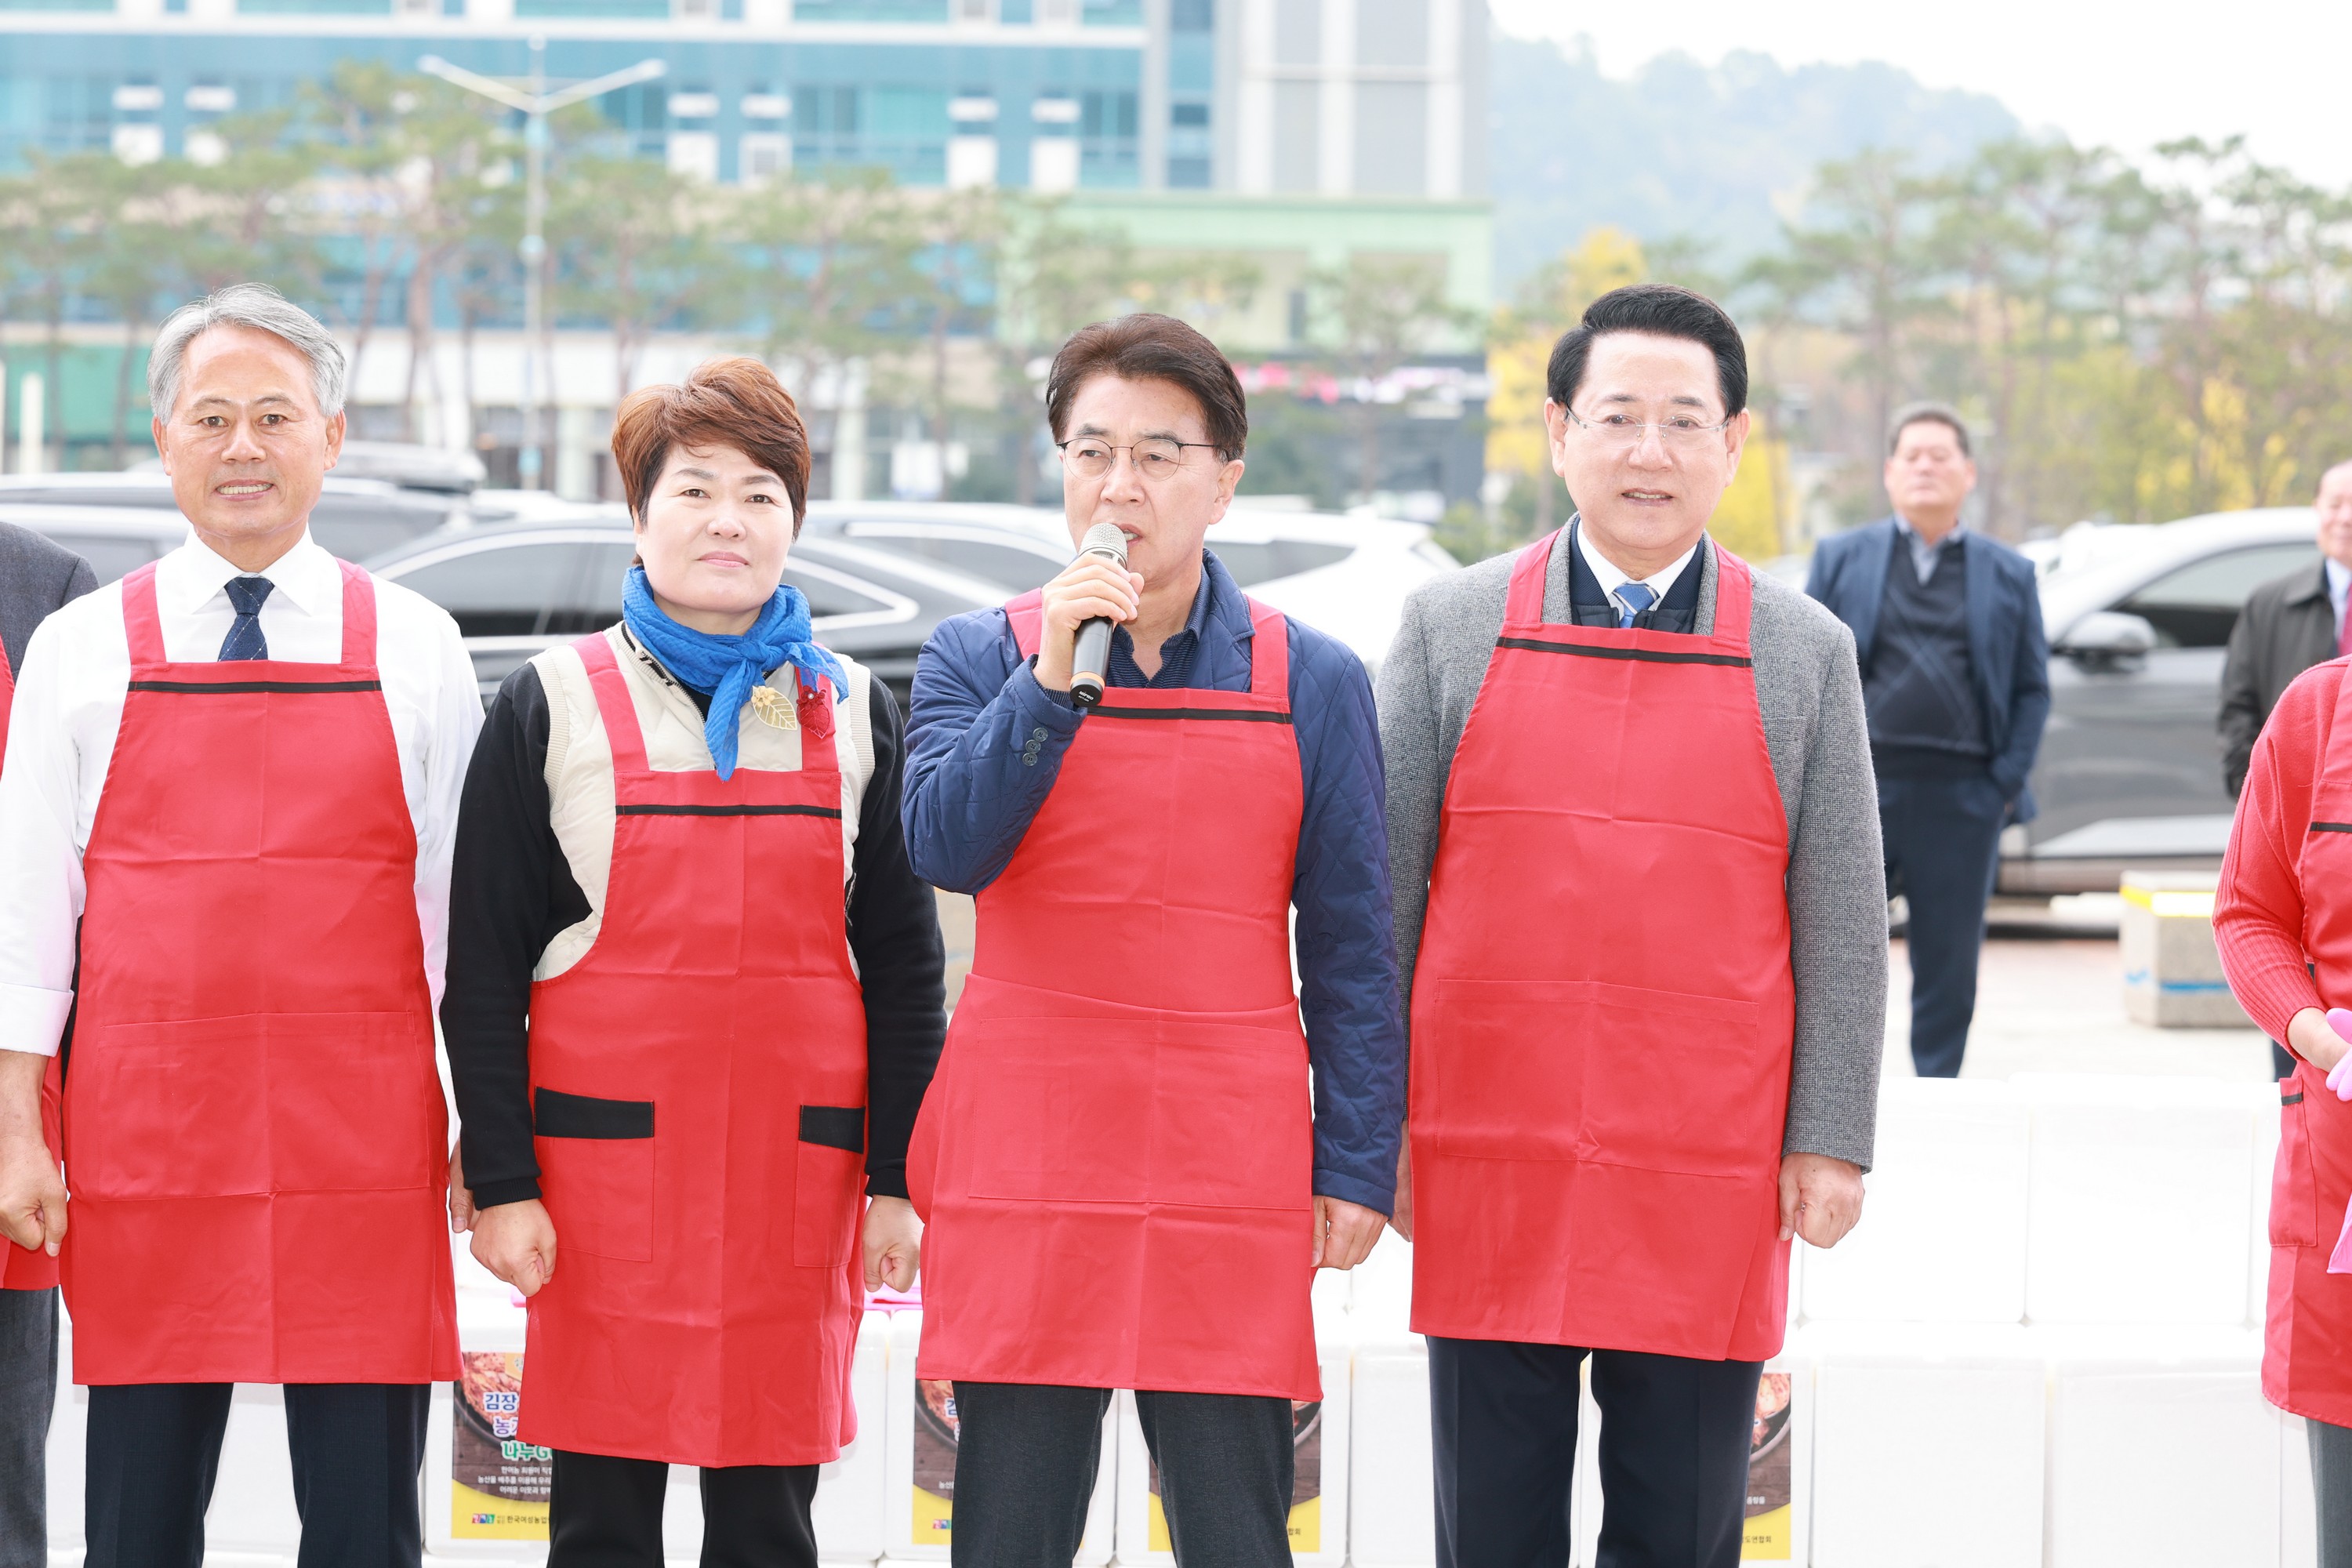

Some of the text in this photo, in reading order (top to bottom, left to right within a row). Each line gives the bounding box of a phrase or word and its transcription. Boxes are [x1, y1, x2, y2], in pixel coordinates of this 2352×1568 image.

[485, 1393, 518, 1411] 김장
[503, 1442, 552, 1460] 나누G
[1741, 1535, 1772, 1544] 도연합회
